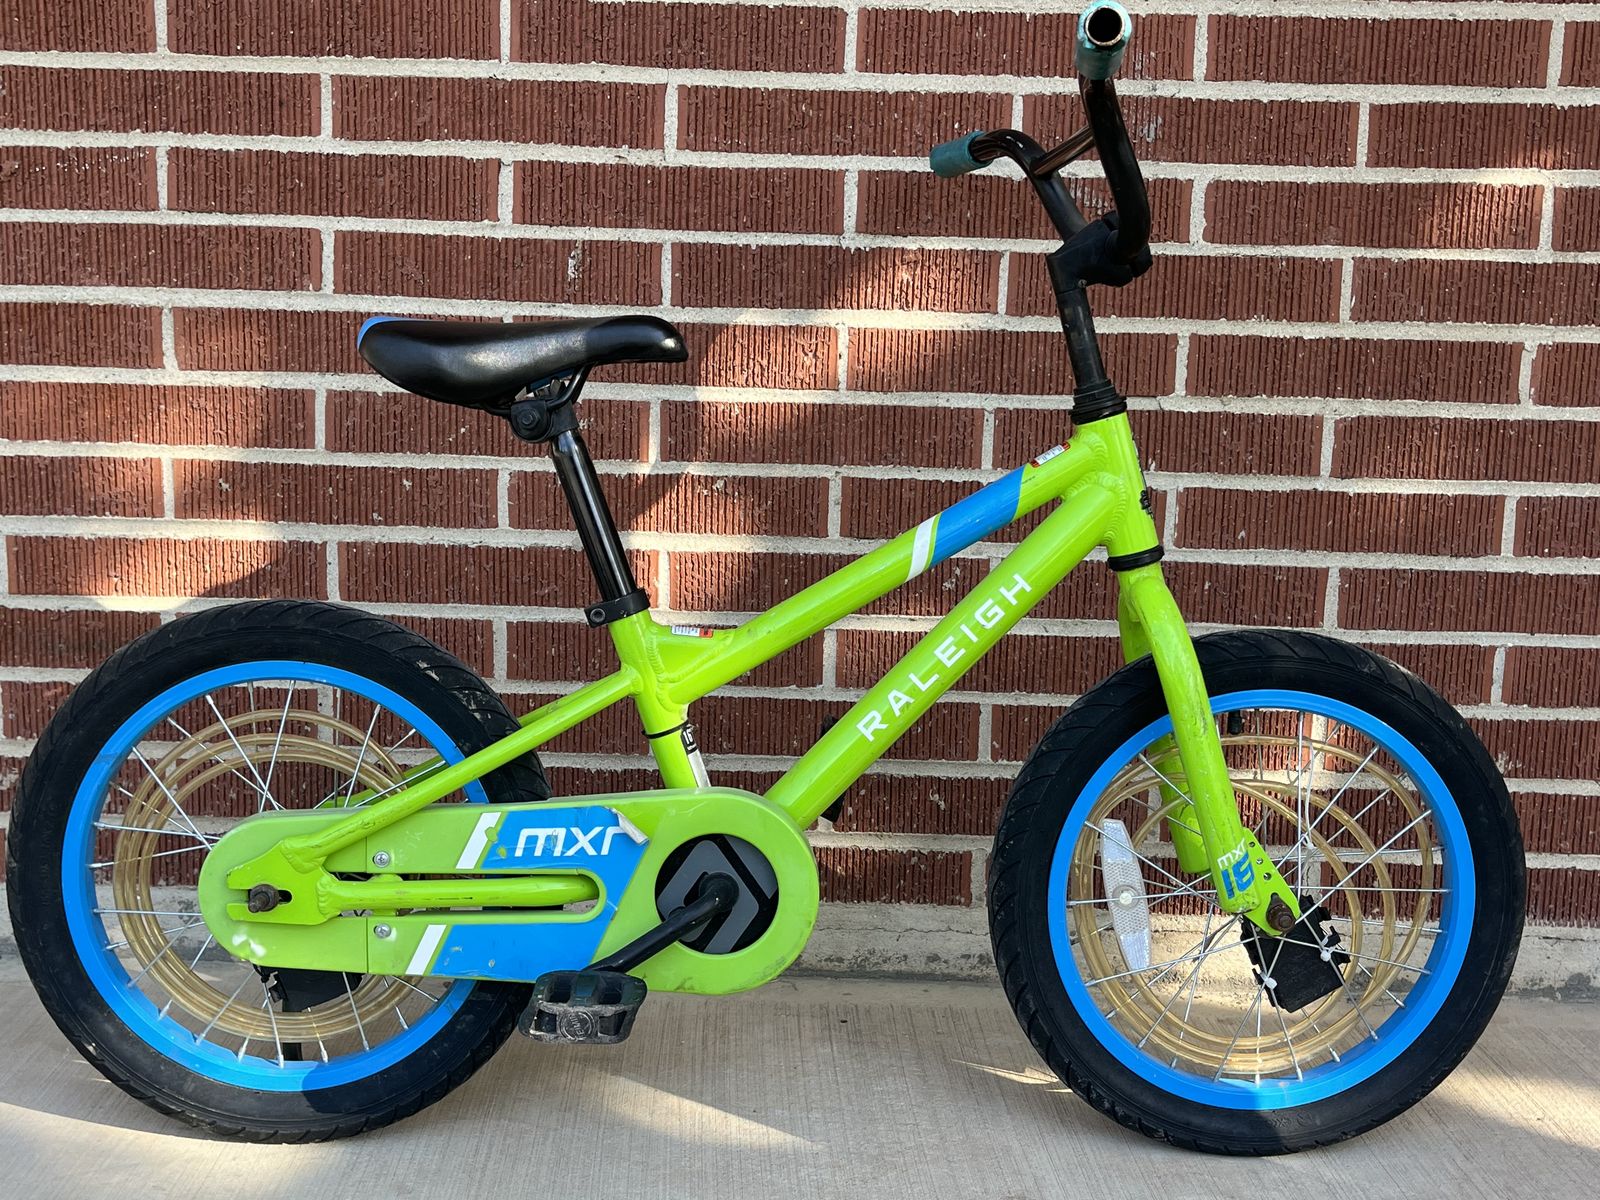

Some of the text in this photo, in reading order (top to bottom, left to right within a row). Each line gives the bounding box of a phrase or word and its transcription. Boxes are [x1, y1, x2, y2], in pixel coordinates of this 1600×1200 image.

[856, 573, 1032, 742] RALEIGH
[514, 826, 627, 857] mxr
[1217, 837, 1246, 869] mxr
[1221, 851, 1255, 900] 16
